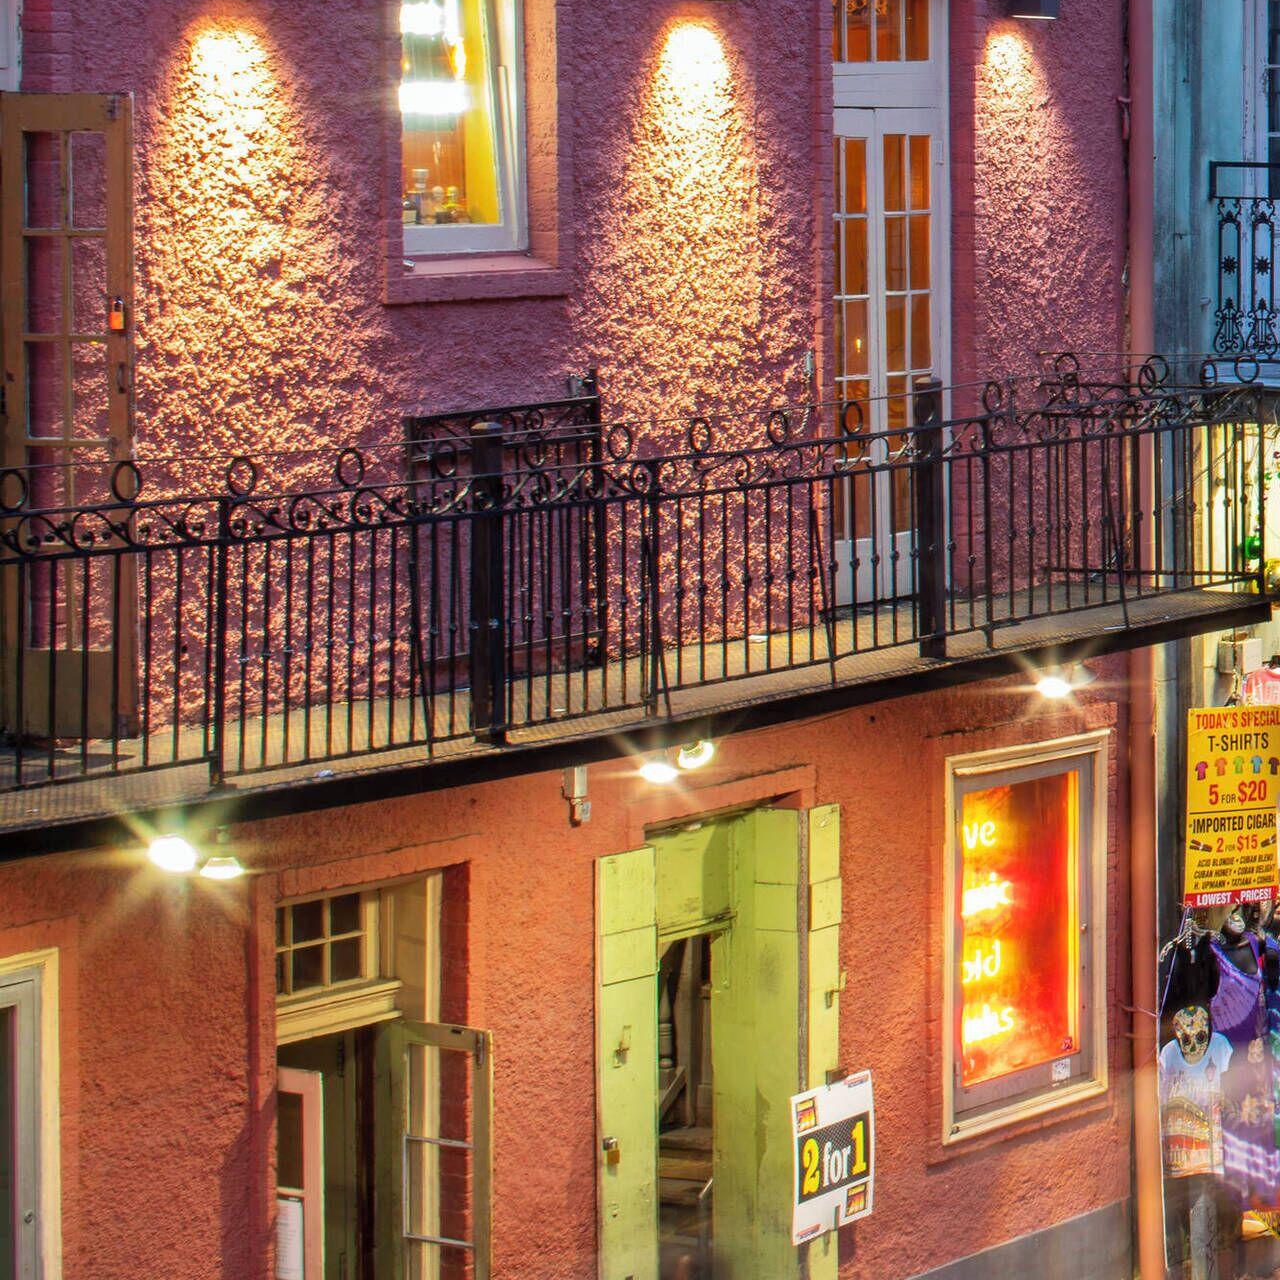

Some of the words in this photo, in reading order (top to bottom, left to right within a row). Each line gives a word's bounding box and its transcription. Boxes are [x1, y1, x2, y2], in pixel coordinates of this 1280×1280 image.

[1196, 711, 1238, 730] TODAY'S
[1241, 710, 1280, 729] SPECIAL
[1208, 732, 1269, 752] T-SHIRTS
[1209, 784, 1219, 805] 5
[1221, 792, 1236, 804] FOR
[1238, 780, 1267, 805] $20
[1216, 837, 1224, 853] 2
[1237, 834, 1258, 852] $15
[1197, 892, 1232, 906] LOWEST
[1240, 888, 1272, 902] PRICES!
[803, 1138, 821, 1195] 2
[823, 1140, 852, 1188] for
[850, 1120, 867, 1176] 1
